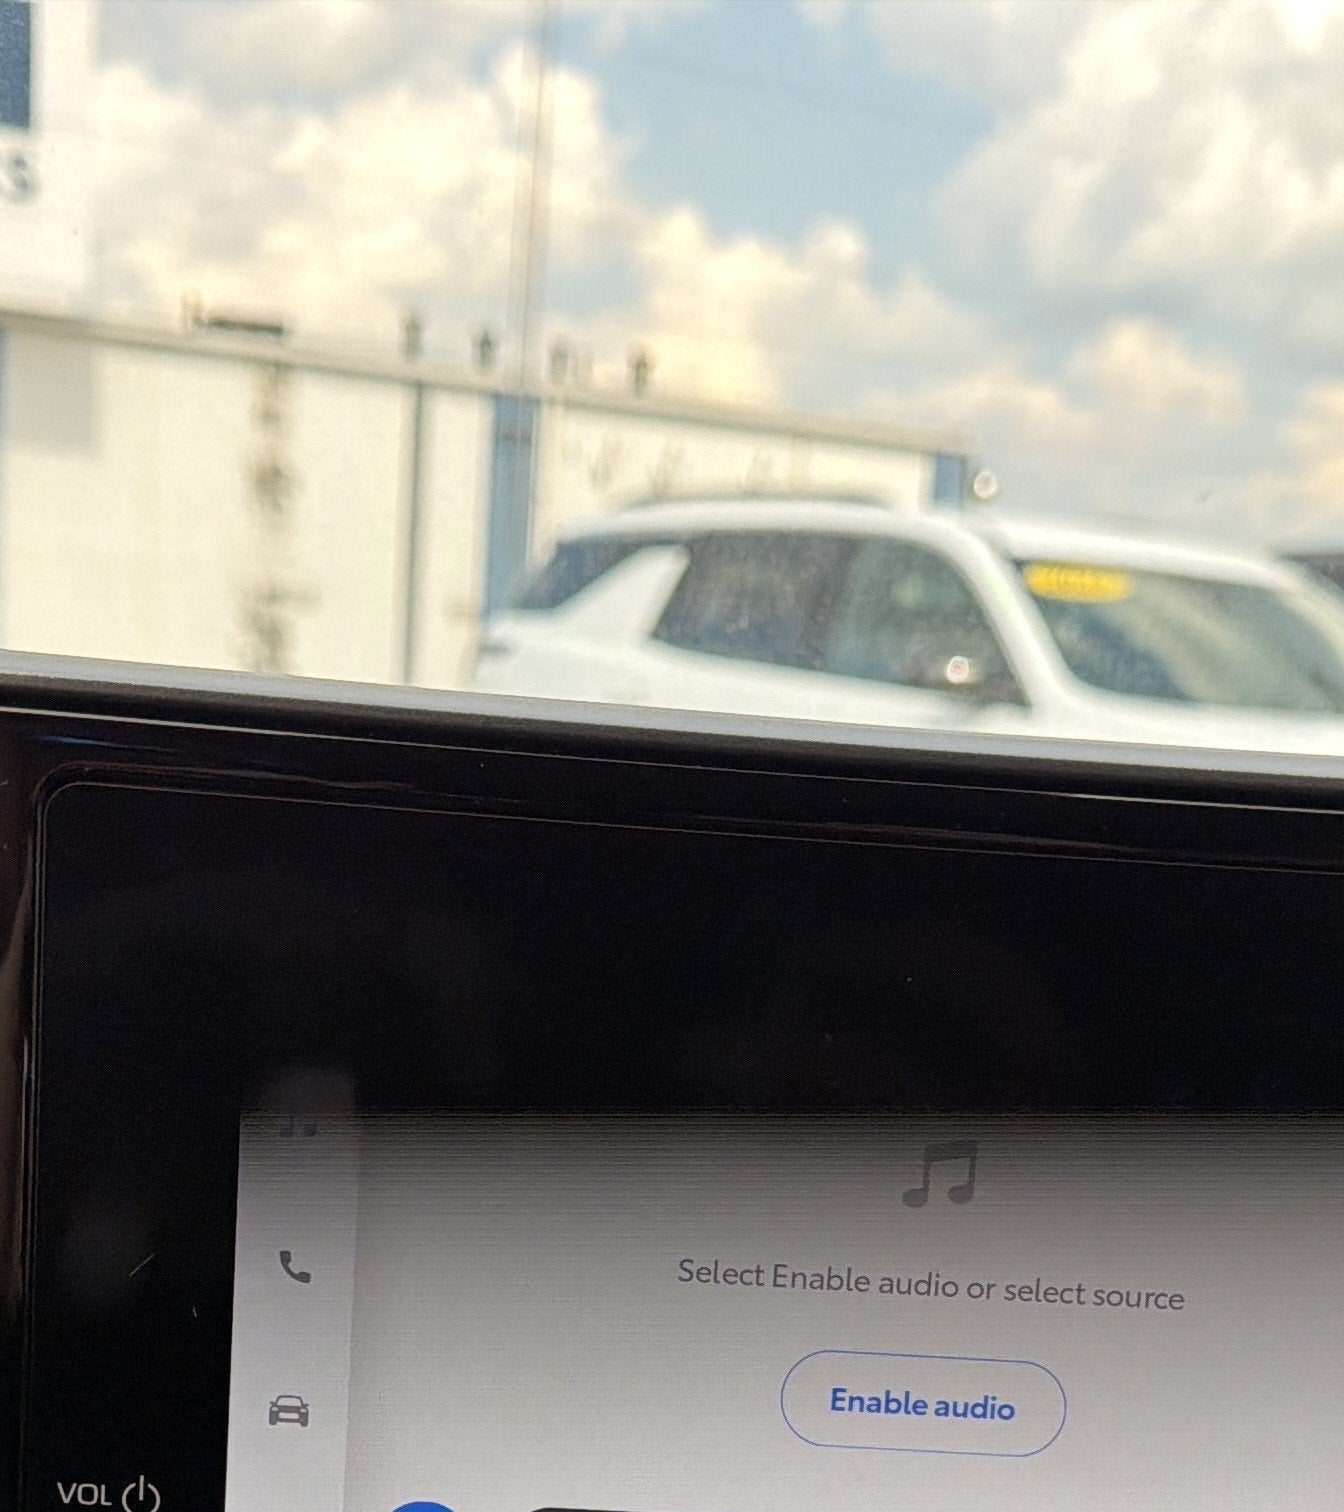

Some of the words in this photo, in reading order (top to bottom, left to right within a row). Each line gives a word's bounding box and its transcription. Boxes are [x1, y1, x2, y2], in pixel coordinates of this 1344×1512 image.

[677, 1257, 765, 1287] Select
[772, 1263, 871, 1293] Enable
[878, 1270, 960, 1298] audio
[966, 1281, 997, 1301] or
[1003, 1276, 1087, 1306] select
[1092, 1288, 1186, 1311] source
[830, 1387, 929, 1417] Enable
[933, 1394, 1016, 1421] audio
[56, 1481, 113, 1507] VOL
